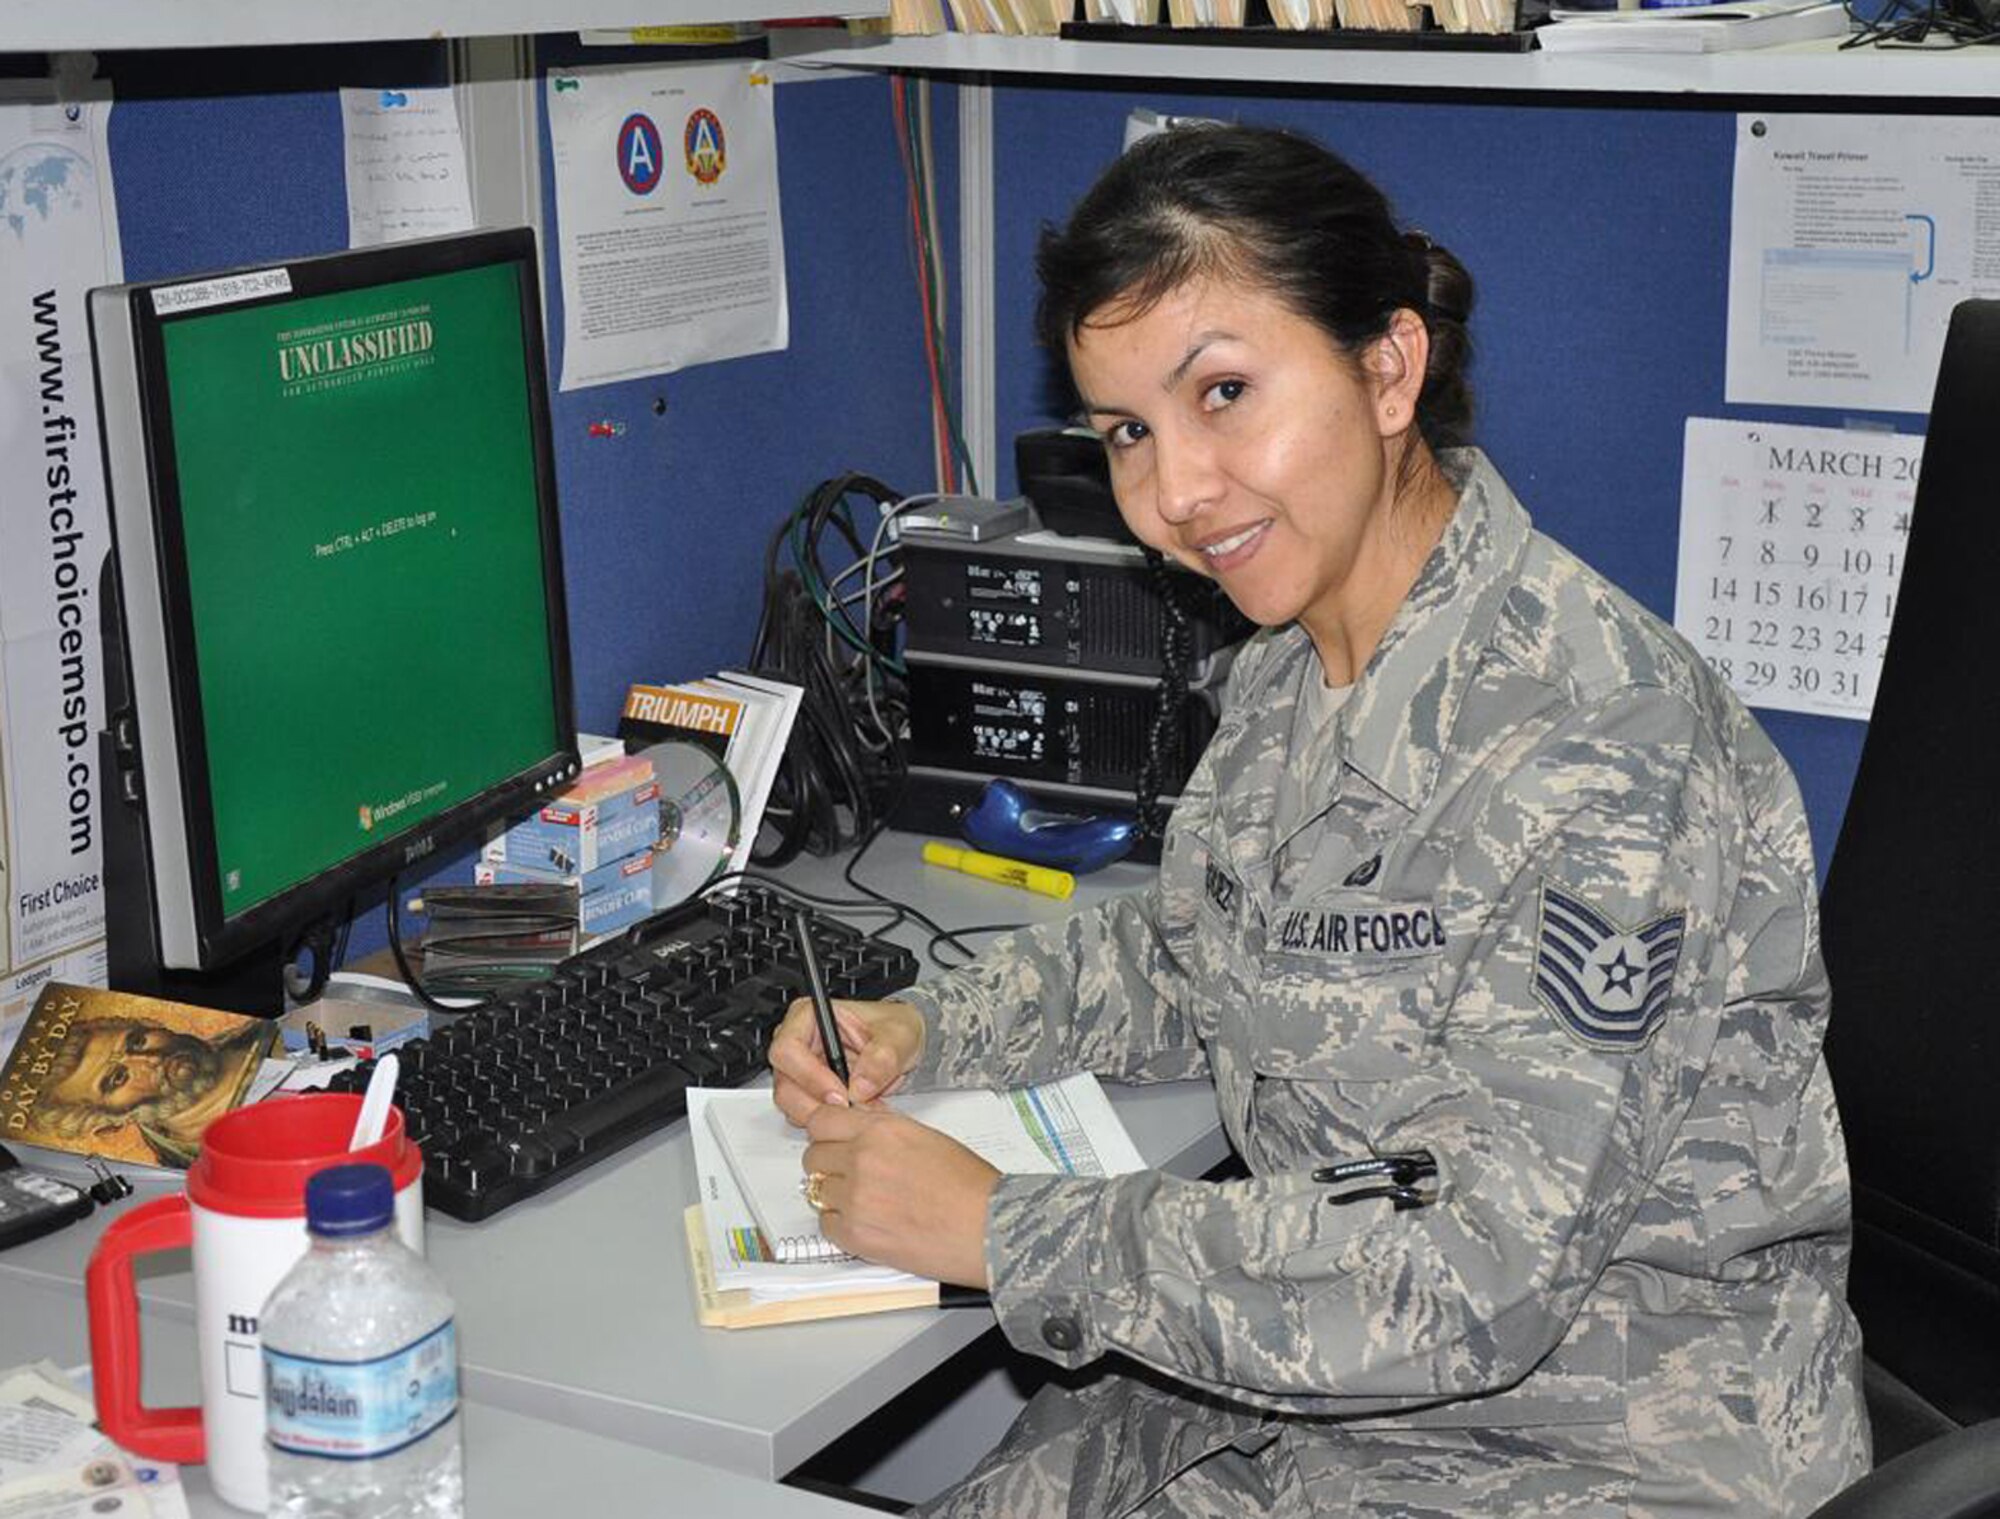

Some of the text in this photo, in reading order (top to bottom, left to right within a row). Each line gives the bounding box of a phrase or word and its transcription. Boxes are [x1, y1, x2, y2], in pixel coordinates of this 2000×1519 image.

[279, 321, 433, 381] UNCLASSIFIED
[1769, 447, 1920, 480] MARCH 20
[31, 289, 93, 855] www.firstchoicemsp.com
[1720, 537, 1732, 559] 7
[1761, 541, 1775, 565] 8
[1804, 545, 1819, 570] 9
[1843, 549, 1872, 574] 10
[1711, 577, 1737, 602] 14
[1754, 581, 1781, 606] 15
[1795, 585, 1824, 610] 16
[1840, 589, 1868, 615] 17
[1705, 616, 1732, 641] 21
[1749, 620, 1779, 646] 22
[1791, 625, 1821, 651] 23
[1835, 630, 1865, 655] 24
[1745, 661, 1776, 686] 29
[1788, 666, 1820, 692] 30
[1832, 671, 1860, 697] 31
[628, 691, 731, 735] TRIUMPH
[20, 873, 99, 917] First Choice
[1311, 912, 1349, 952] AIR
[8, 995, 80, 1130] DAY BY DAY
